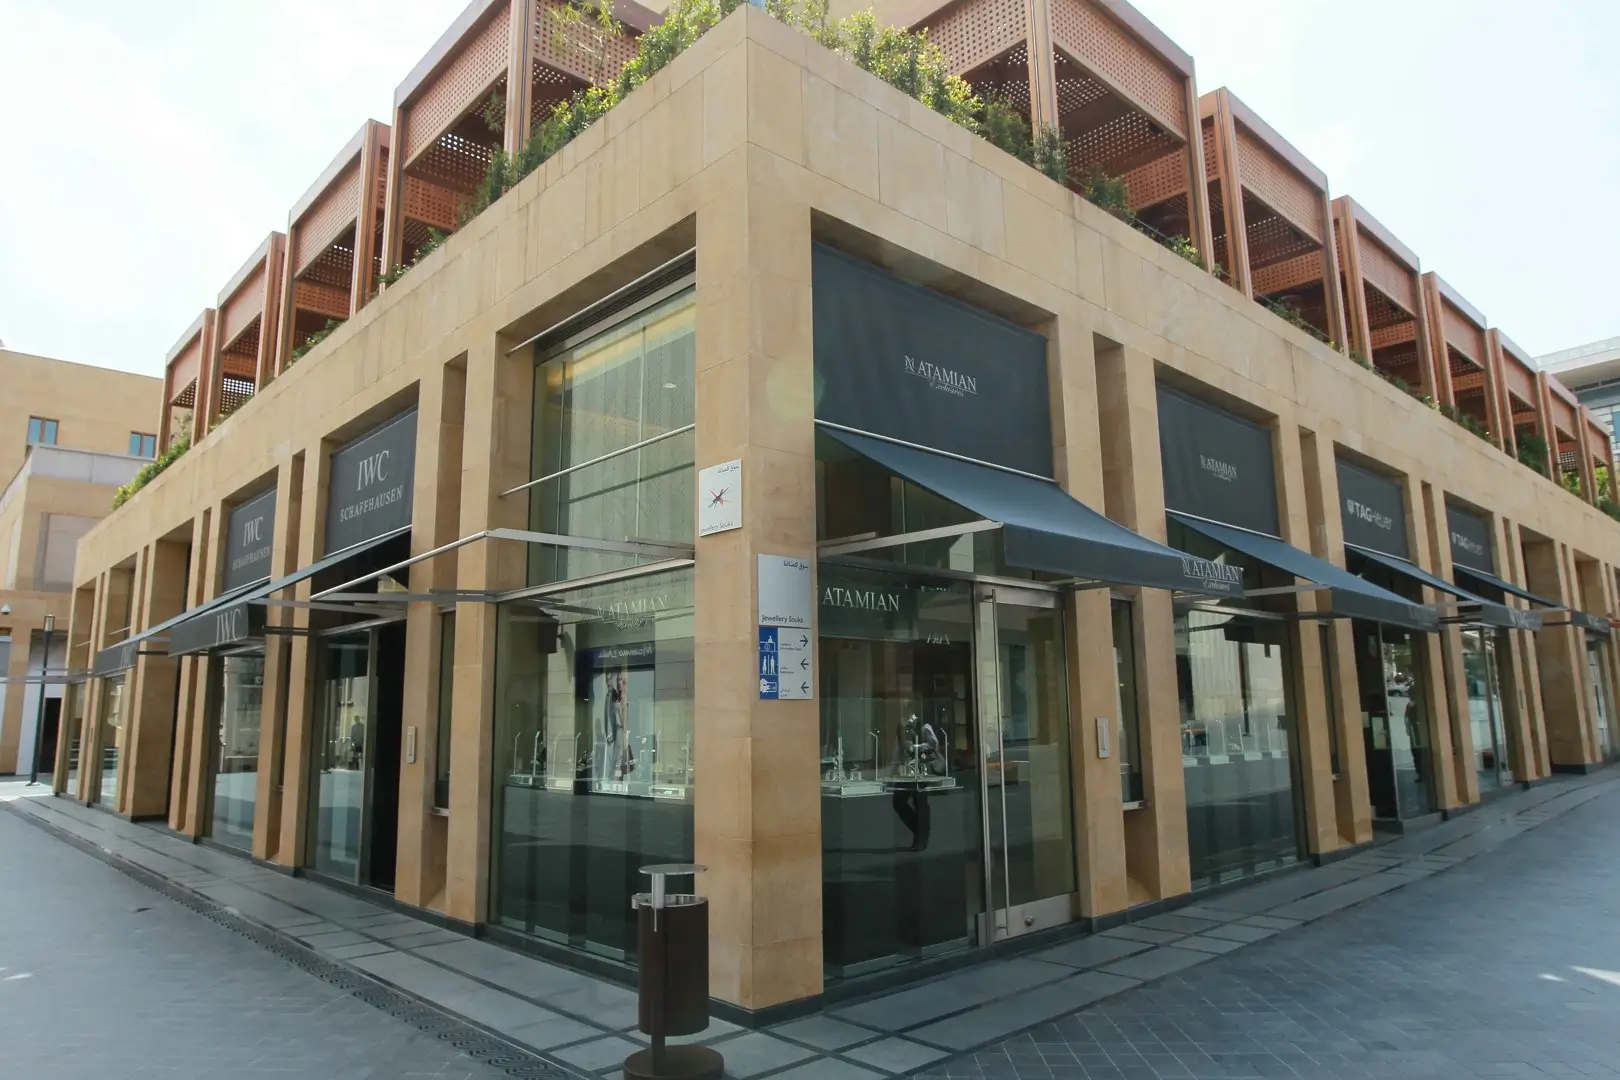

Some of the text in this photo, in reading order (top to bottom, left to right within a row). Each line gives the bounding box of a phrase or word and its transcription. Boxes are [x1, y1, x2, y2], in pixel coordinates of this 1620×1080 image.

[904, 355, 977, 392] NATAMIAN
[356, 450, 390, 491] IWC
[340, 485, 404, 522] SCHAFFHAUSEN
[243, 516, 264, 548] IWC
[1182, 556, 1239, 582] NATAMIAN
[818, 586, 900, 612] ATAMIAN
[215, 608, 241, 646] IWC
[761, 614, 804, 624] Jewellery Souks
